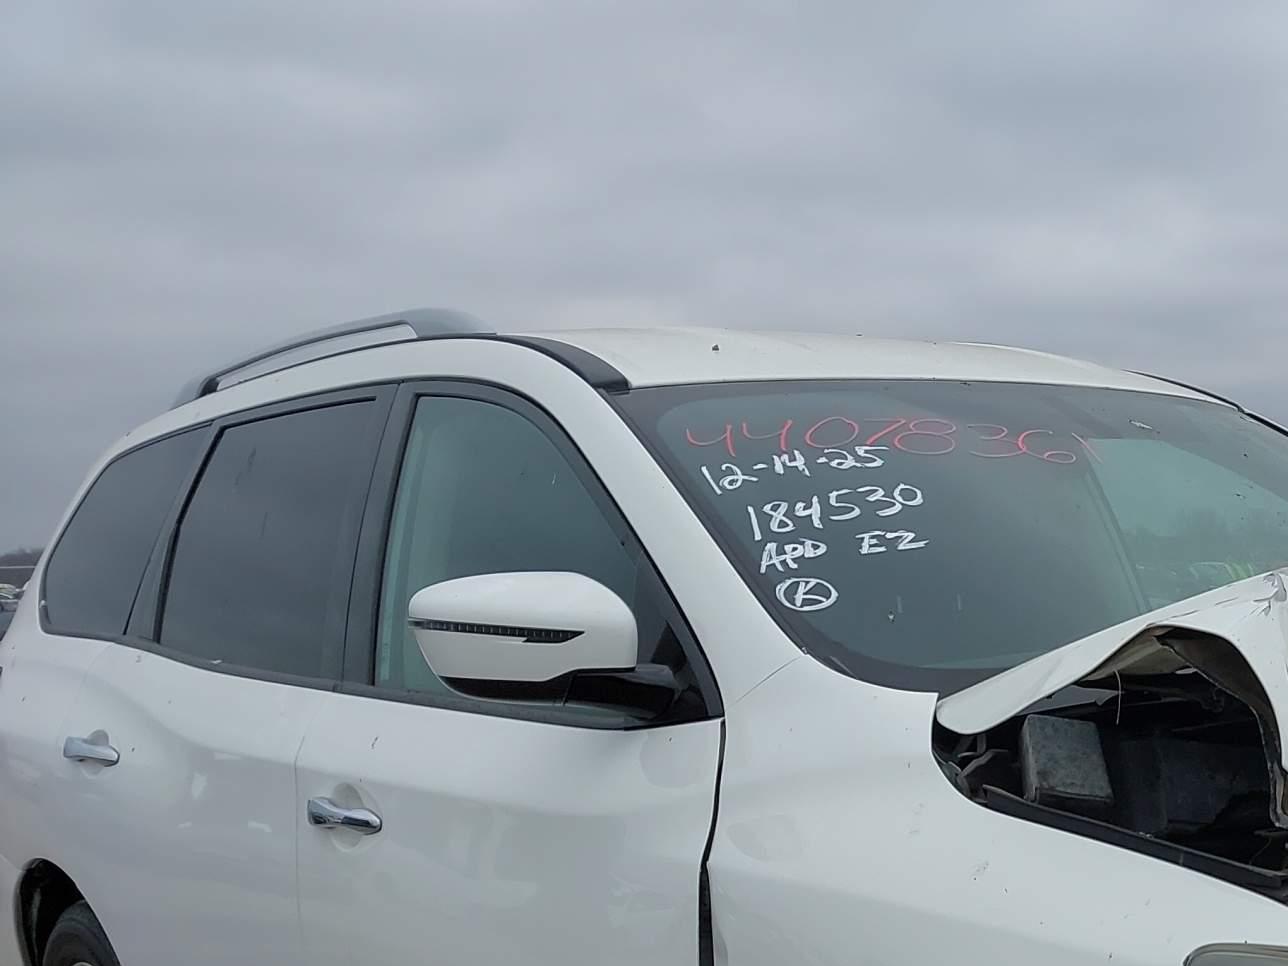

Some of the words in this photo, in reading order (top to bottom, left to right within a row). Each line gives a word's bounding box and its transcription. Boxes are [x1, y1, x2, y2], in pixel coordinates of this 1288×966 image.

[686, 416, 1104, 465] 44078361
[701, 446, 889, 495] 12-14-25
[747, 483, 924, 541] 184530
